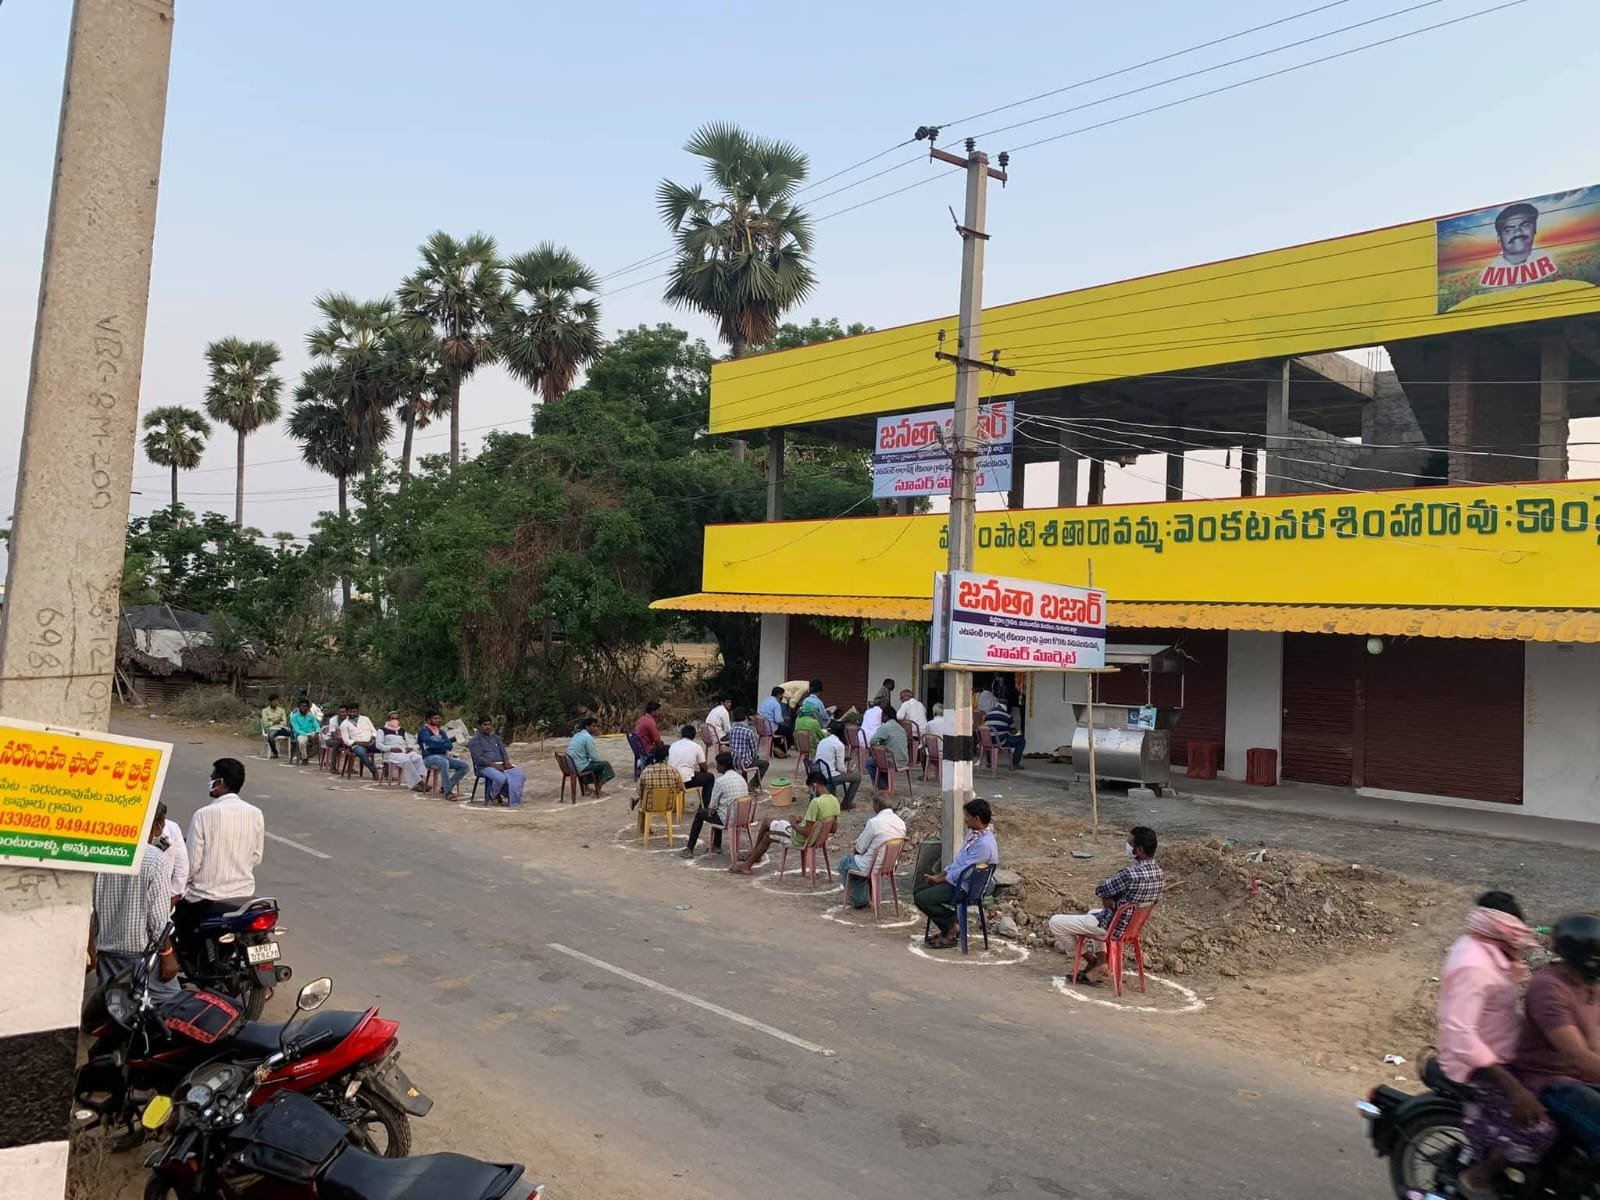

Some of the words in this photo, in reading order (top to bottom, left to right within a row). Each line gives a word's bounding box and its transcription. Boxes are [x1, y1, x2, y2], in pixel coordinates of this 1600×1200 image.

[1481, 256, 1556, 286] MVNR
[879, 417, 940, 450] జనతా
[894, 475, 935, 493] సూపర్
[958, 578, 1034, 617] జనతా
[1039, 591, 1102, 626] బజార్
[29, 608, 65, 670] 698
[987, 643, 1030, 661] సూపర్
[1033, 648, 1077, 668] మార్కెట్
[48, 801, 83, 814] గ్రామం
[56, 816, 138, 839] 9494133986
